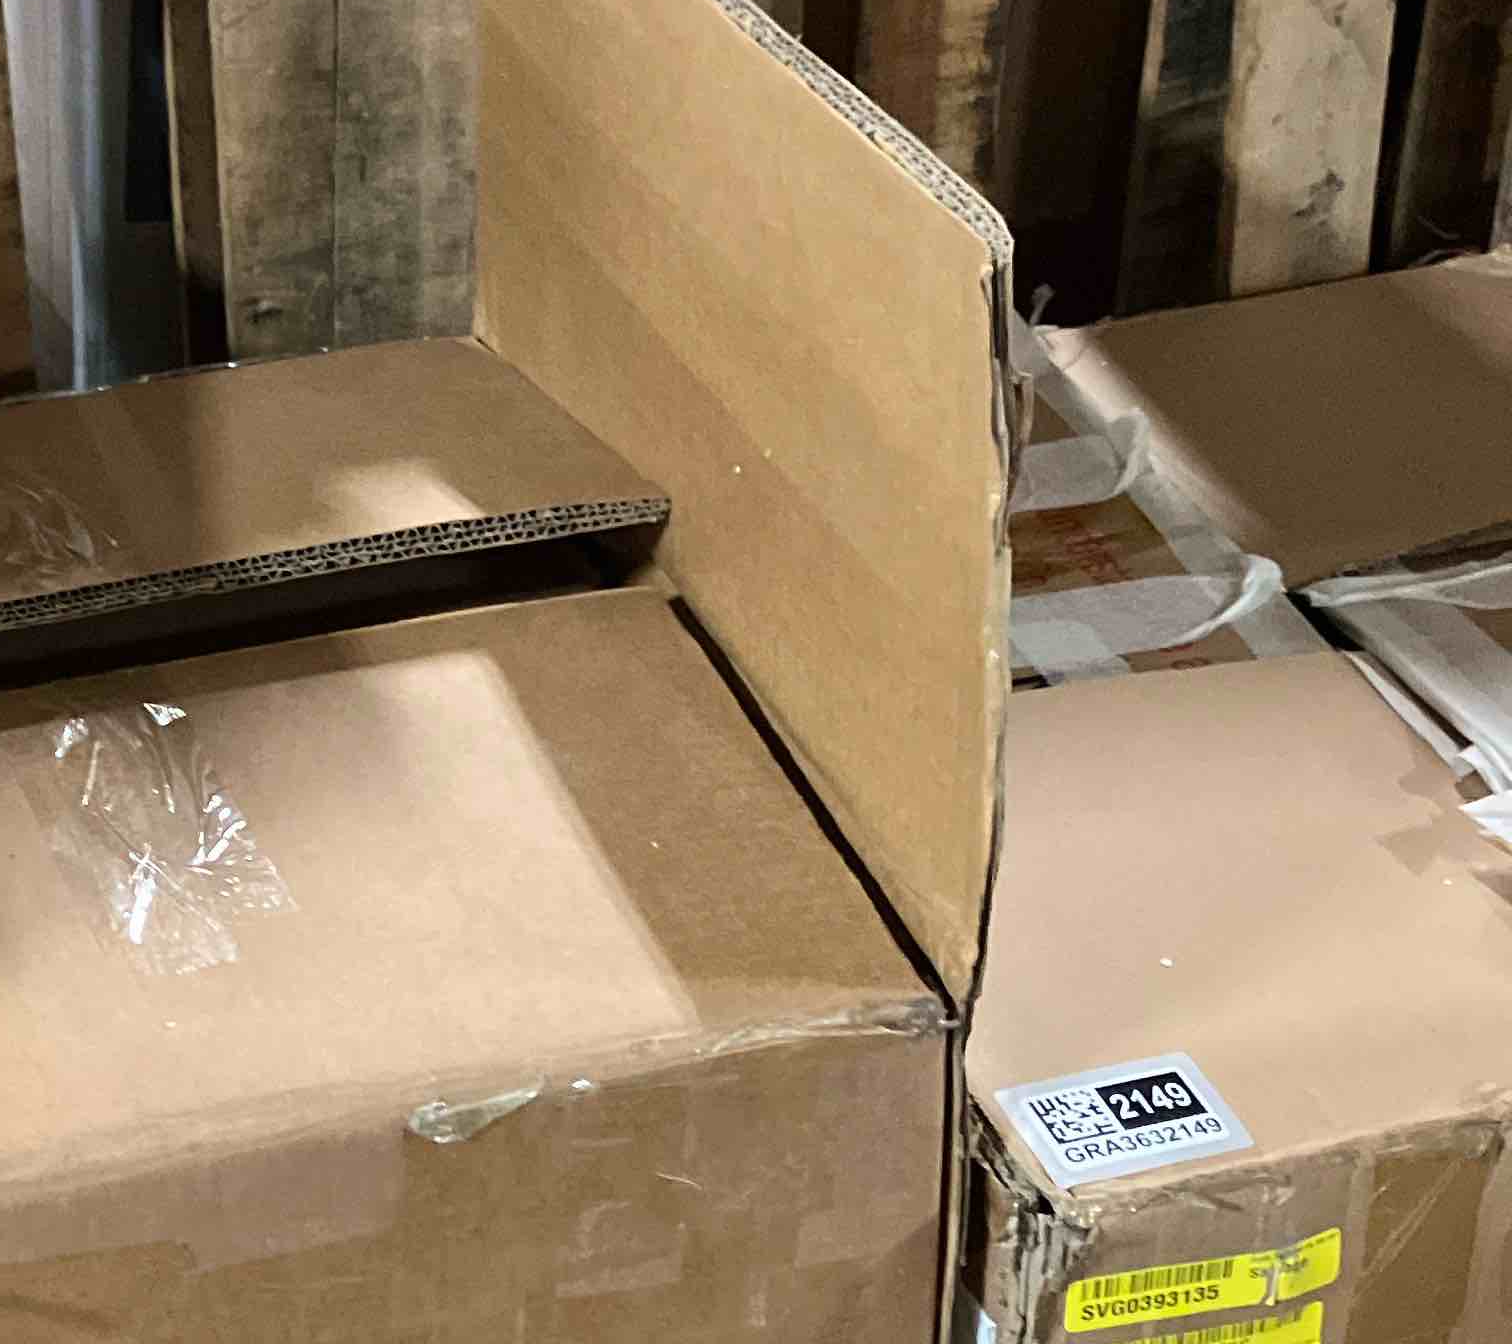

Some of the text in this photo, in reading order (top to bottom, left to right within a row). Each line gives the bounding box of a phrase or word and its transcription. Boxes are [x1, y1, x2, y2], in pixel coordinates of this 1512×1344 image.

[1109, 1082, 1192, 1121] 2149
[1065, 1116, 1223, 1163] GRA3632149
[1081, 1284, 1220, 1322] SVG0393135
